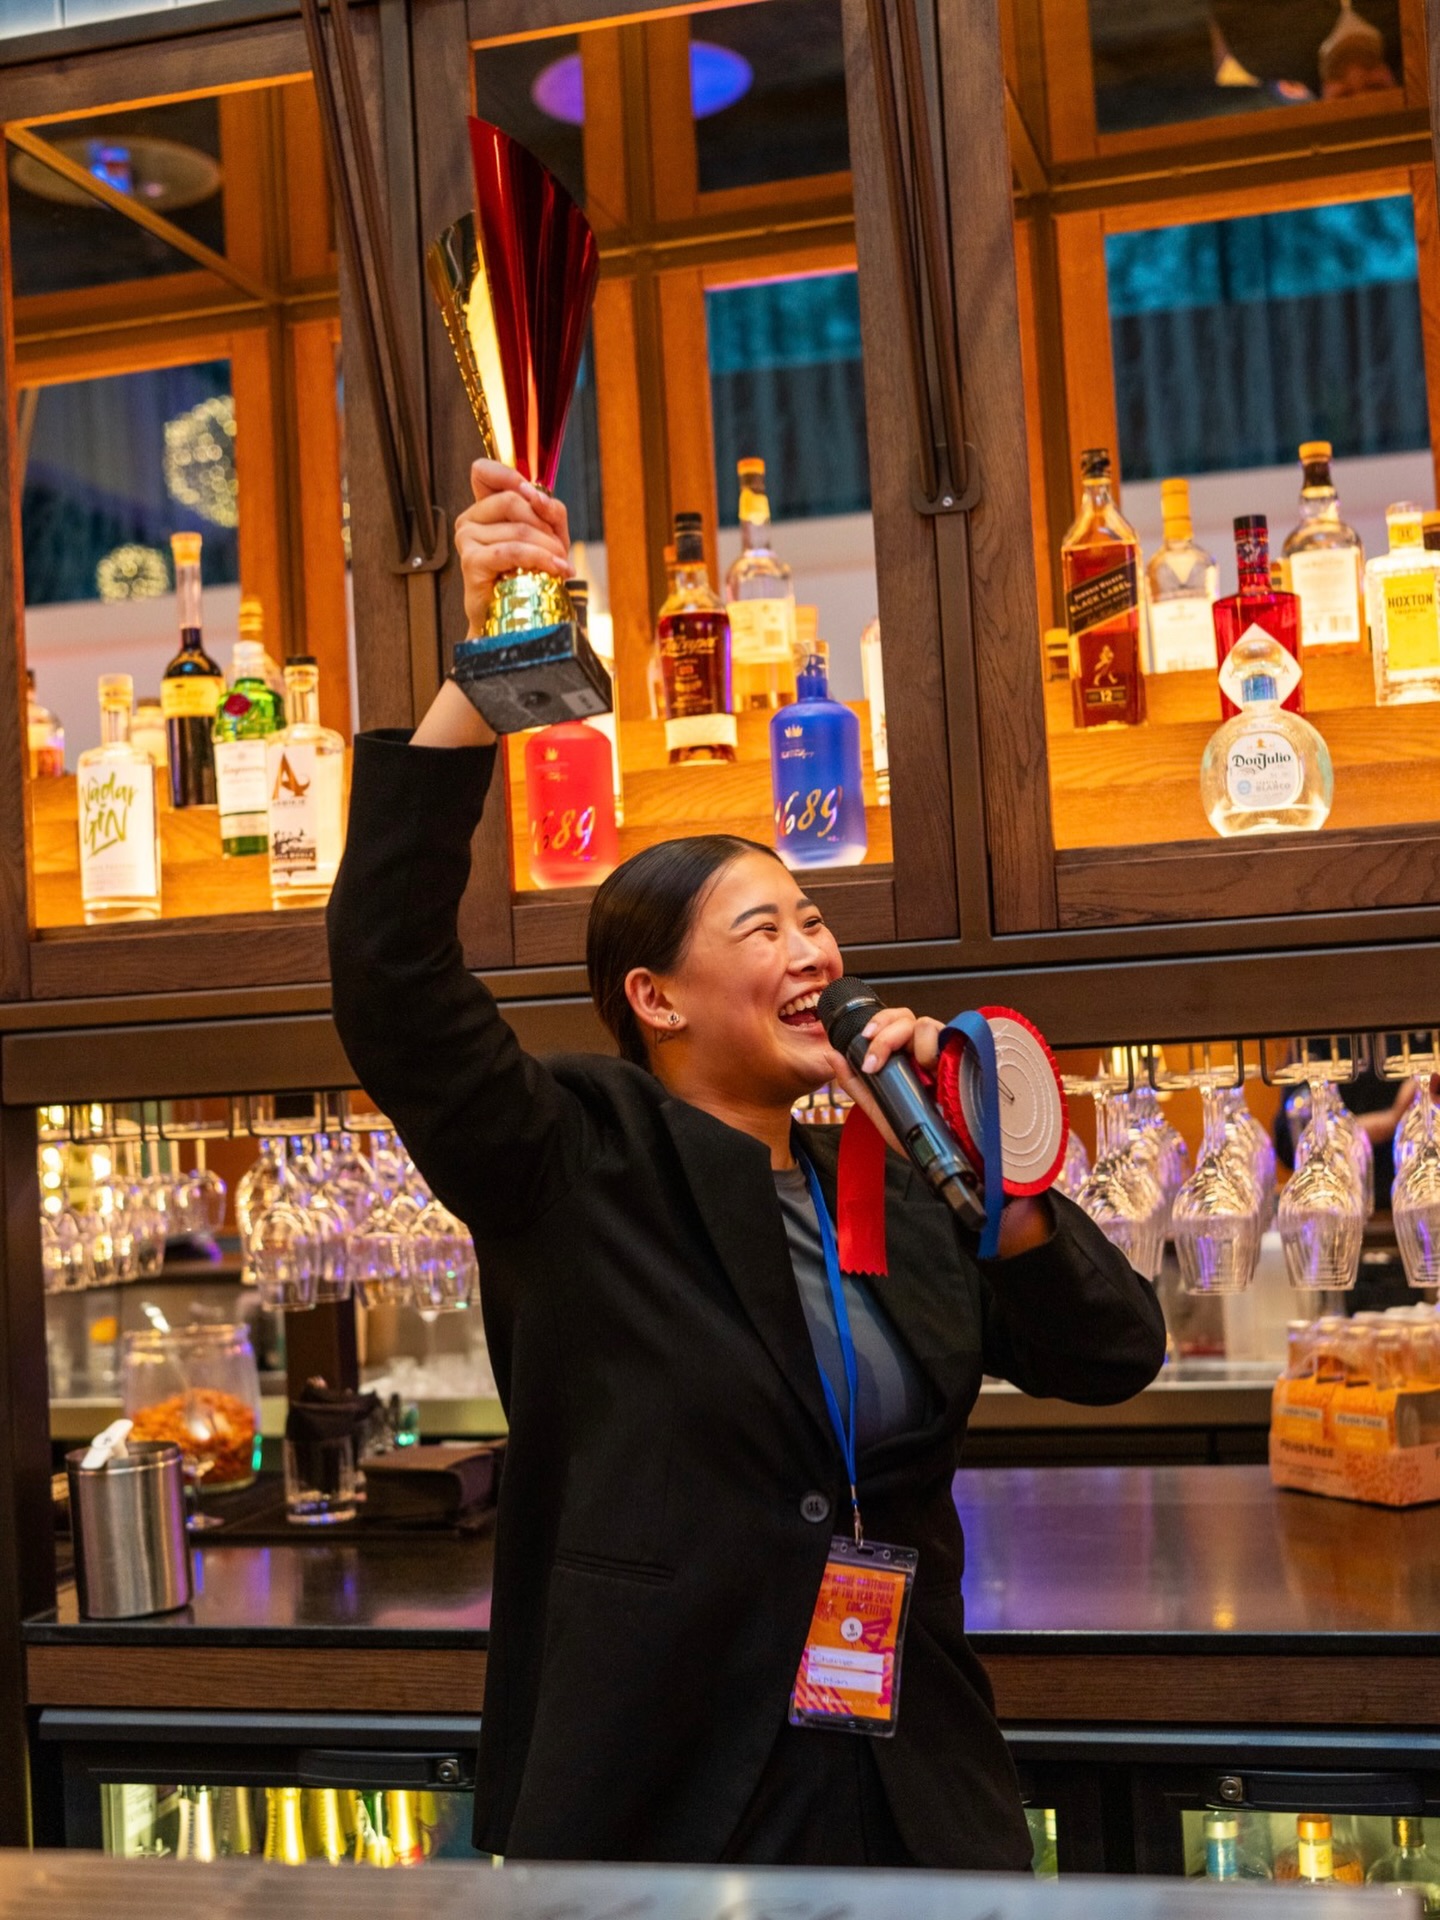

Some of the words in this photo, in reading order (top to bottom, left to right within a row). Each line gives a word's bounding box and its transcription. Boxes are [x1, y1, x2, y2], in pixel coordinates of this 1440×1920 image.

[1069, 593, 1099, 613] BLACK
[1100, 581, 1131, 599] LABEL
[1387, 593, 1433, 608] HOXTON
[1100, 689, 1112, 703] 12
